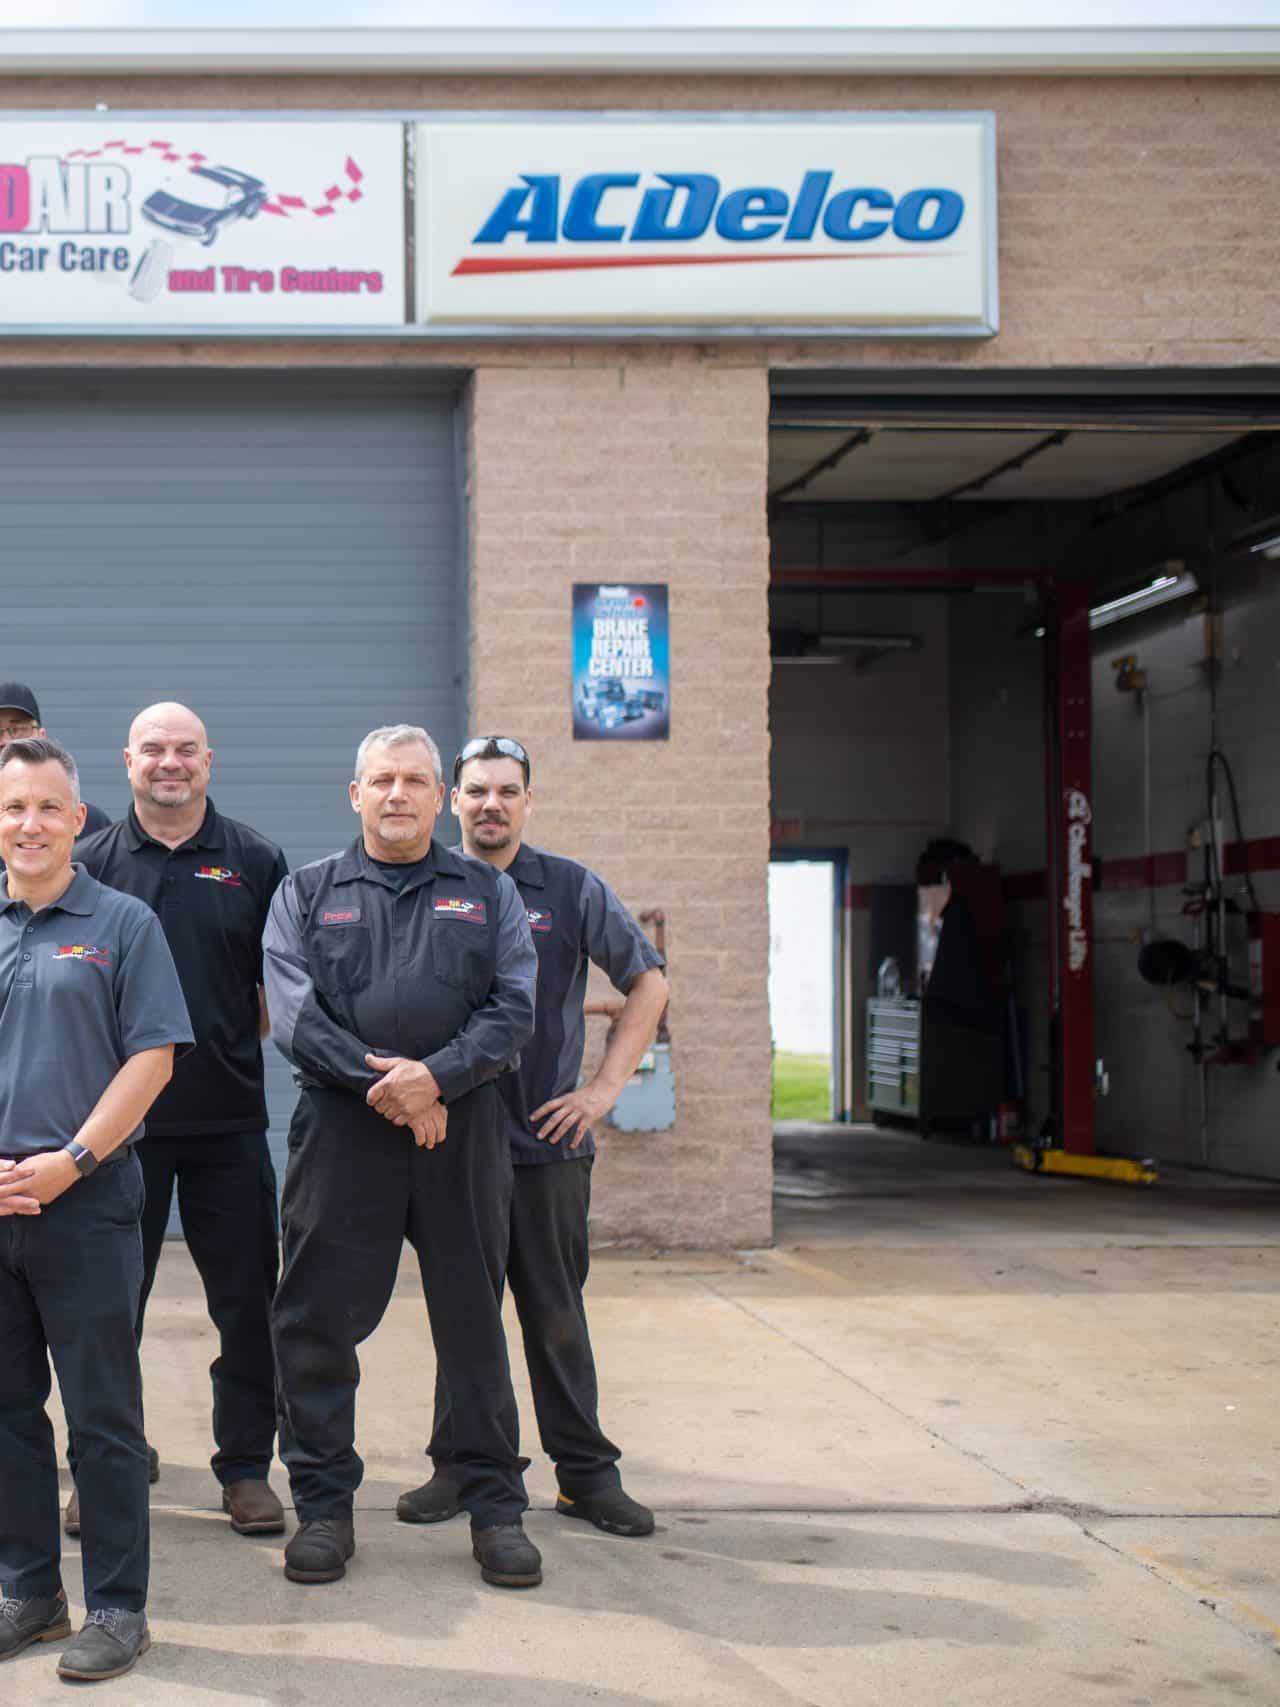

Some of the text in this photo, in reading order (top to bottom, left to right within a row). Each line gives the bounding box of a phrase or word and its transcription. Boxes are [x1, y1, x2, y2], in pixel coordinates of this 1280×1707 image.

[471, 169, 966, 244] ACDelco
[59, 242, 129, 272] Care
[168, 267, 383, 293] and Tire Centers
[589, 657, 653, 677] CENTER
